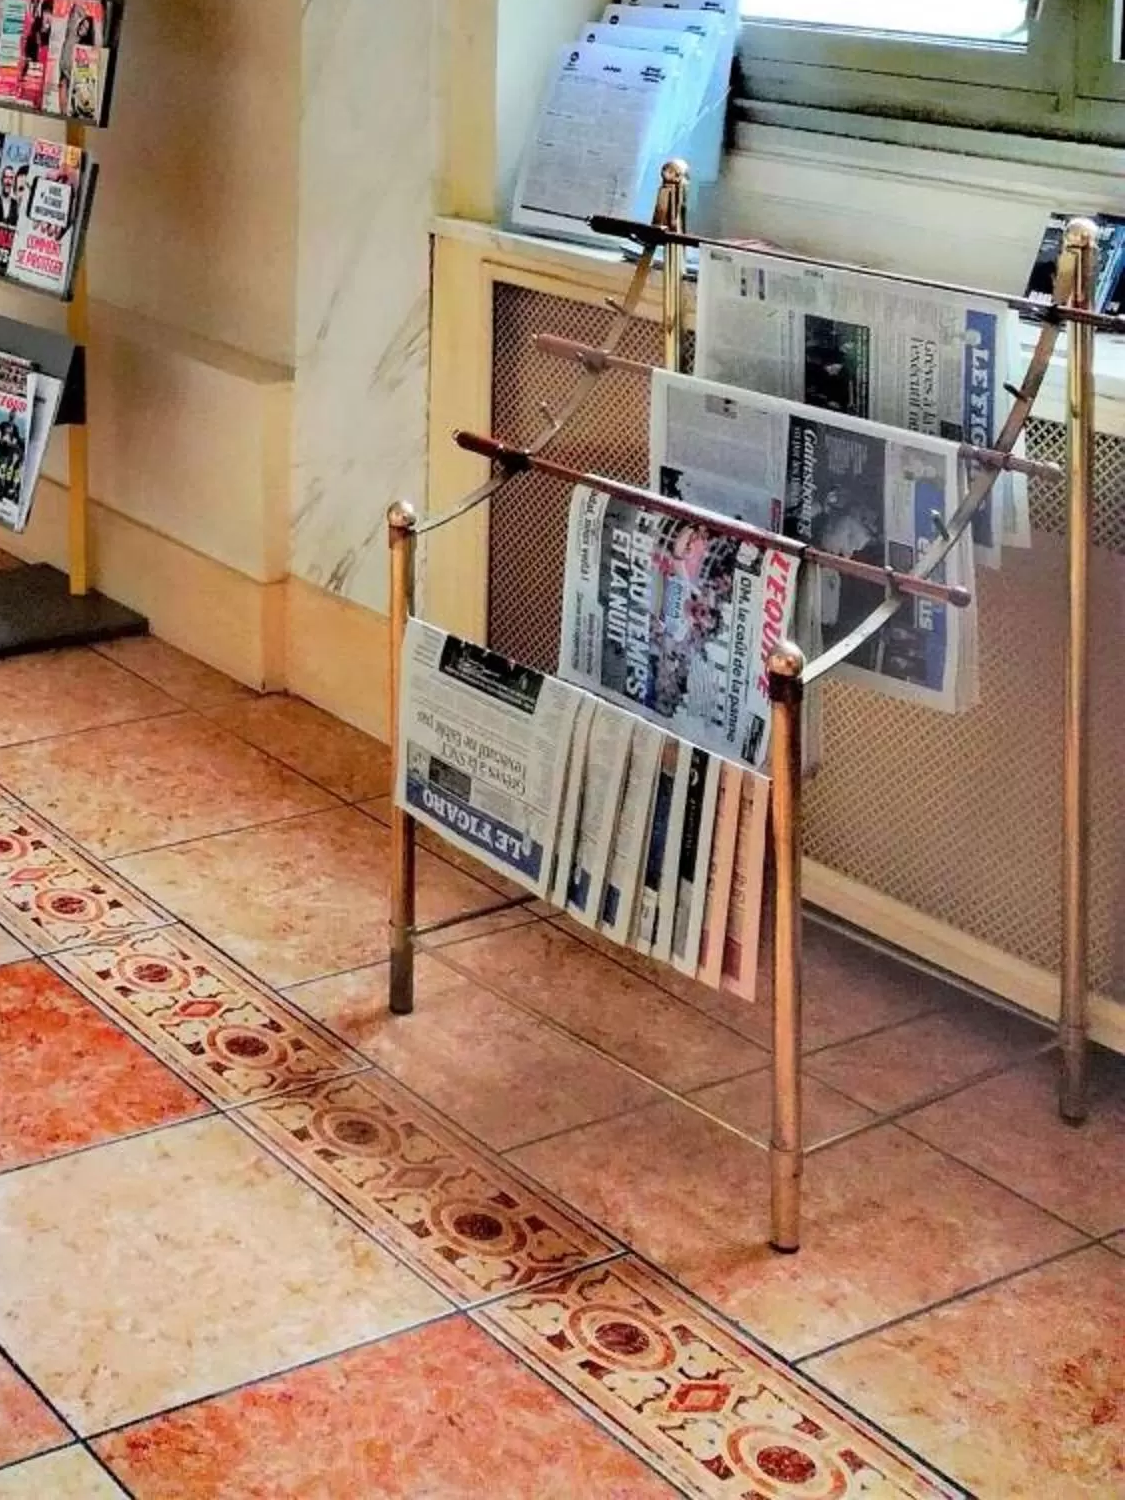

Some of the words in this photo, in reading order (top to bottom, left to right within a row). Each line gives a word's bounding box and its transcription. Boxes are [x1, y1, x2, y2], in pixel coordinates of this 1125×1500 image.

[972, 348, 989, 390] LE
[797, 429, 817, 540] Gainsbourg
[611, 528, 631, 559] ET
[610, 558, 630, 587] LA
[628, 529, 653, 607] BEAU
[738, 576, 752, 604] OM,
[606, 591, 628, 649] NUIT
[737, 606, 750, 622] le
[757, 551, 791, 698] L'EQUE
[625, 608, 650, 699] TEMPS
[734, 623, 748, 657] coût
[731, 678, 743, 694] la
[732, 657, 745, 677] de
[726, 693, 740, 743] panne
[423, 789, 494, 849] FIGARO
[494, 829, 523, 860] LE
